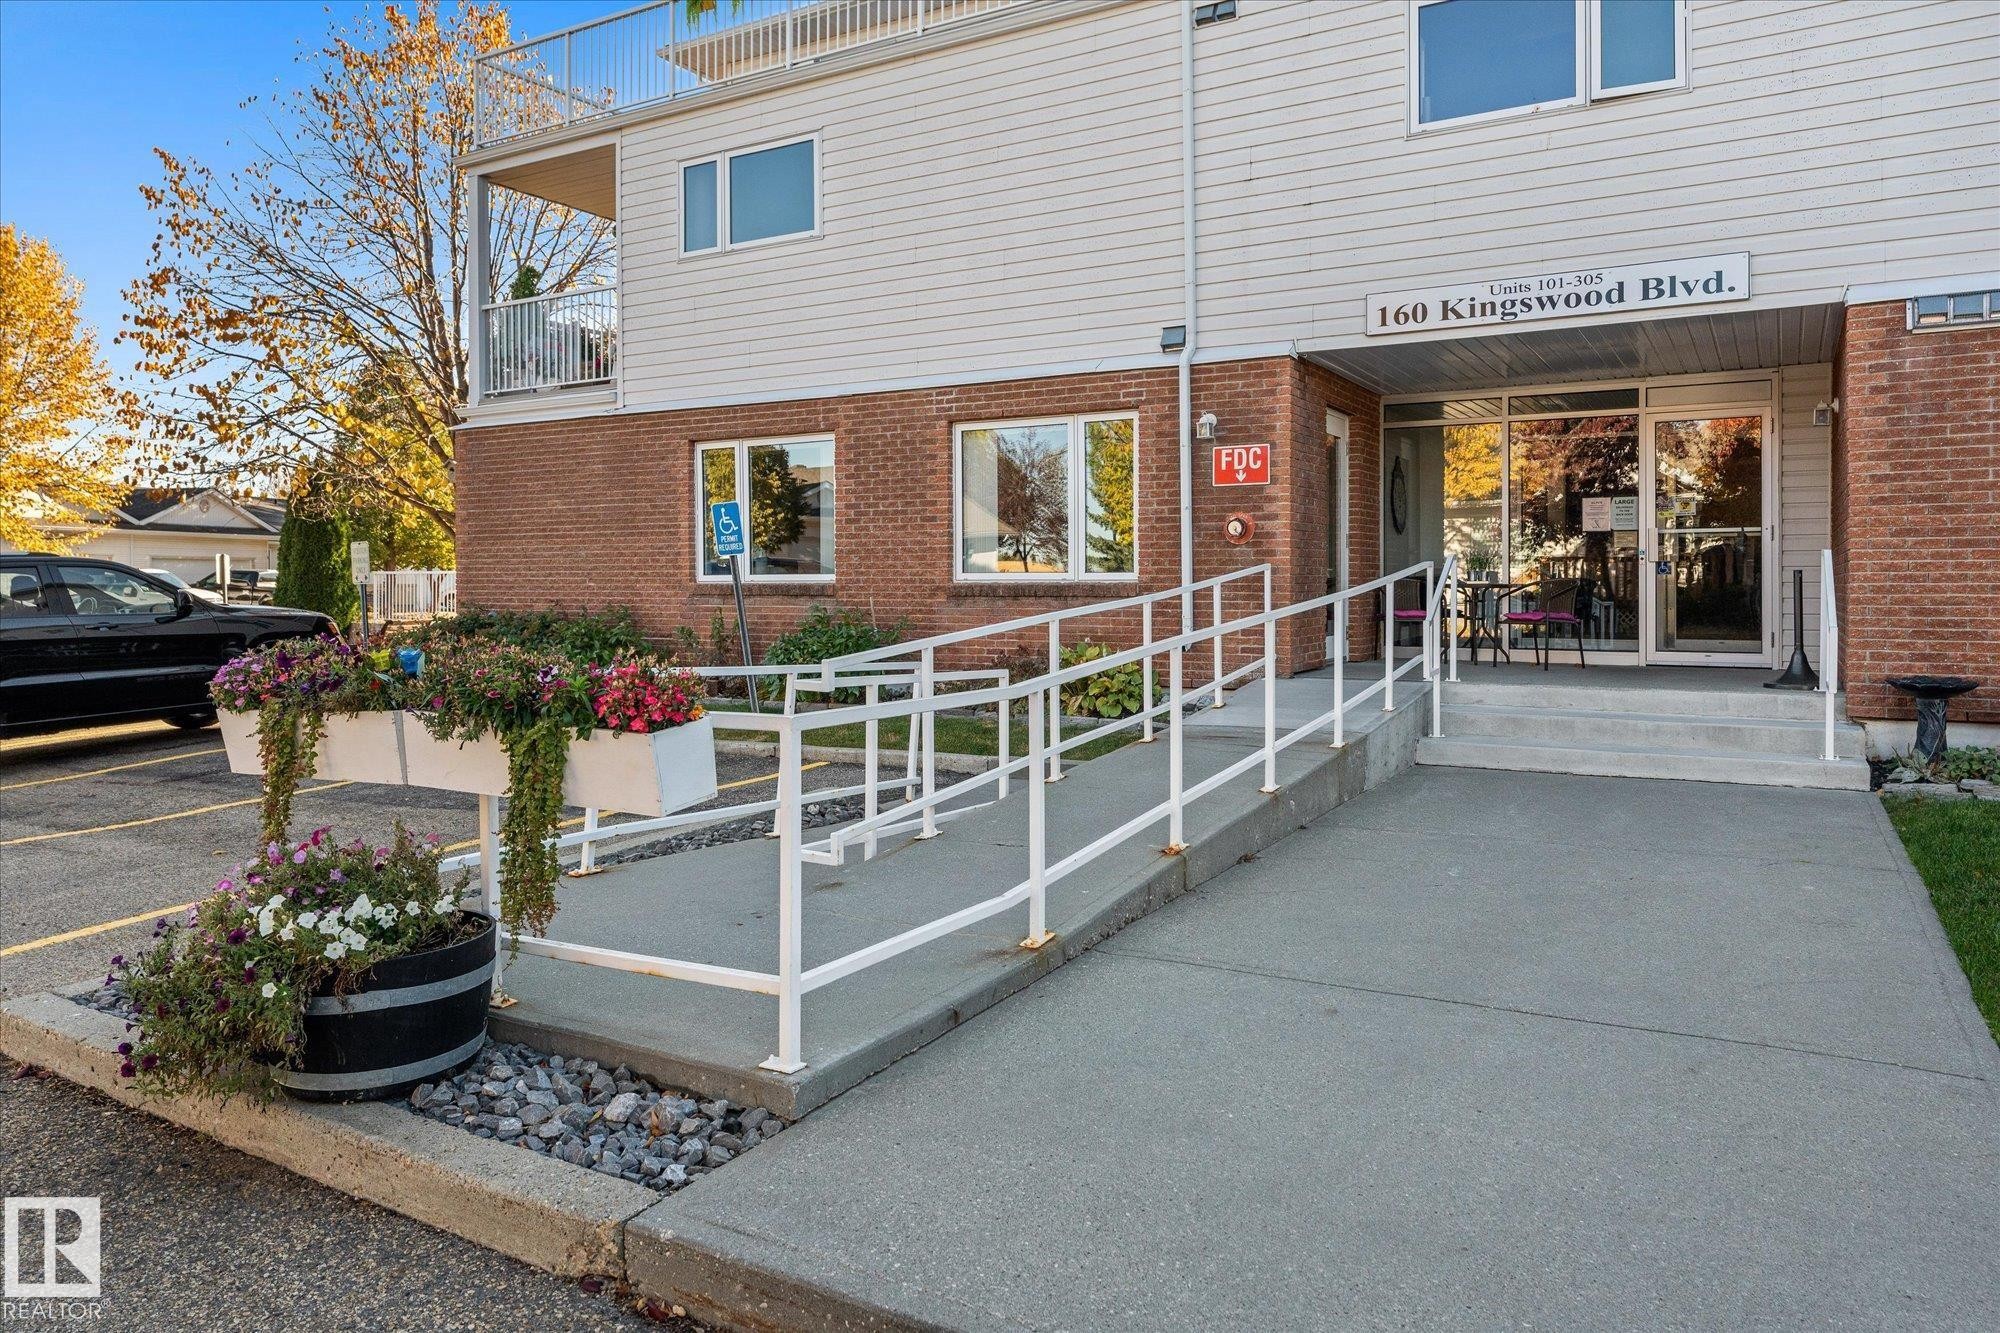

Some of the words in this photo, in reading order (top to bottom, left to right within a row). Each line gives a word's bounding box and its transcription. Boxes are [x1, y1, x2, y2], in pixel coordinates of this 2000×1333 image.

[1490, 282, 1531, 296] Units
[1537, 272, 1604, 291] 101-305
[1376, 302, 1429, 328] 160
[1439, 281, 1625, 321] Kingswood
[1640, 270, 1736, 301] Blvd.
[1221, 447, 1262, 471] FDC
[718, 542, 743, 552] REQUIRED
[720, 534, 739, 543] PERMIT
